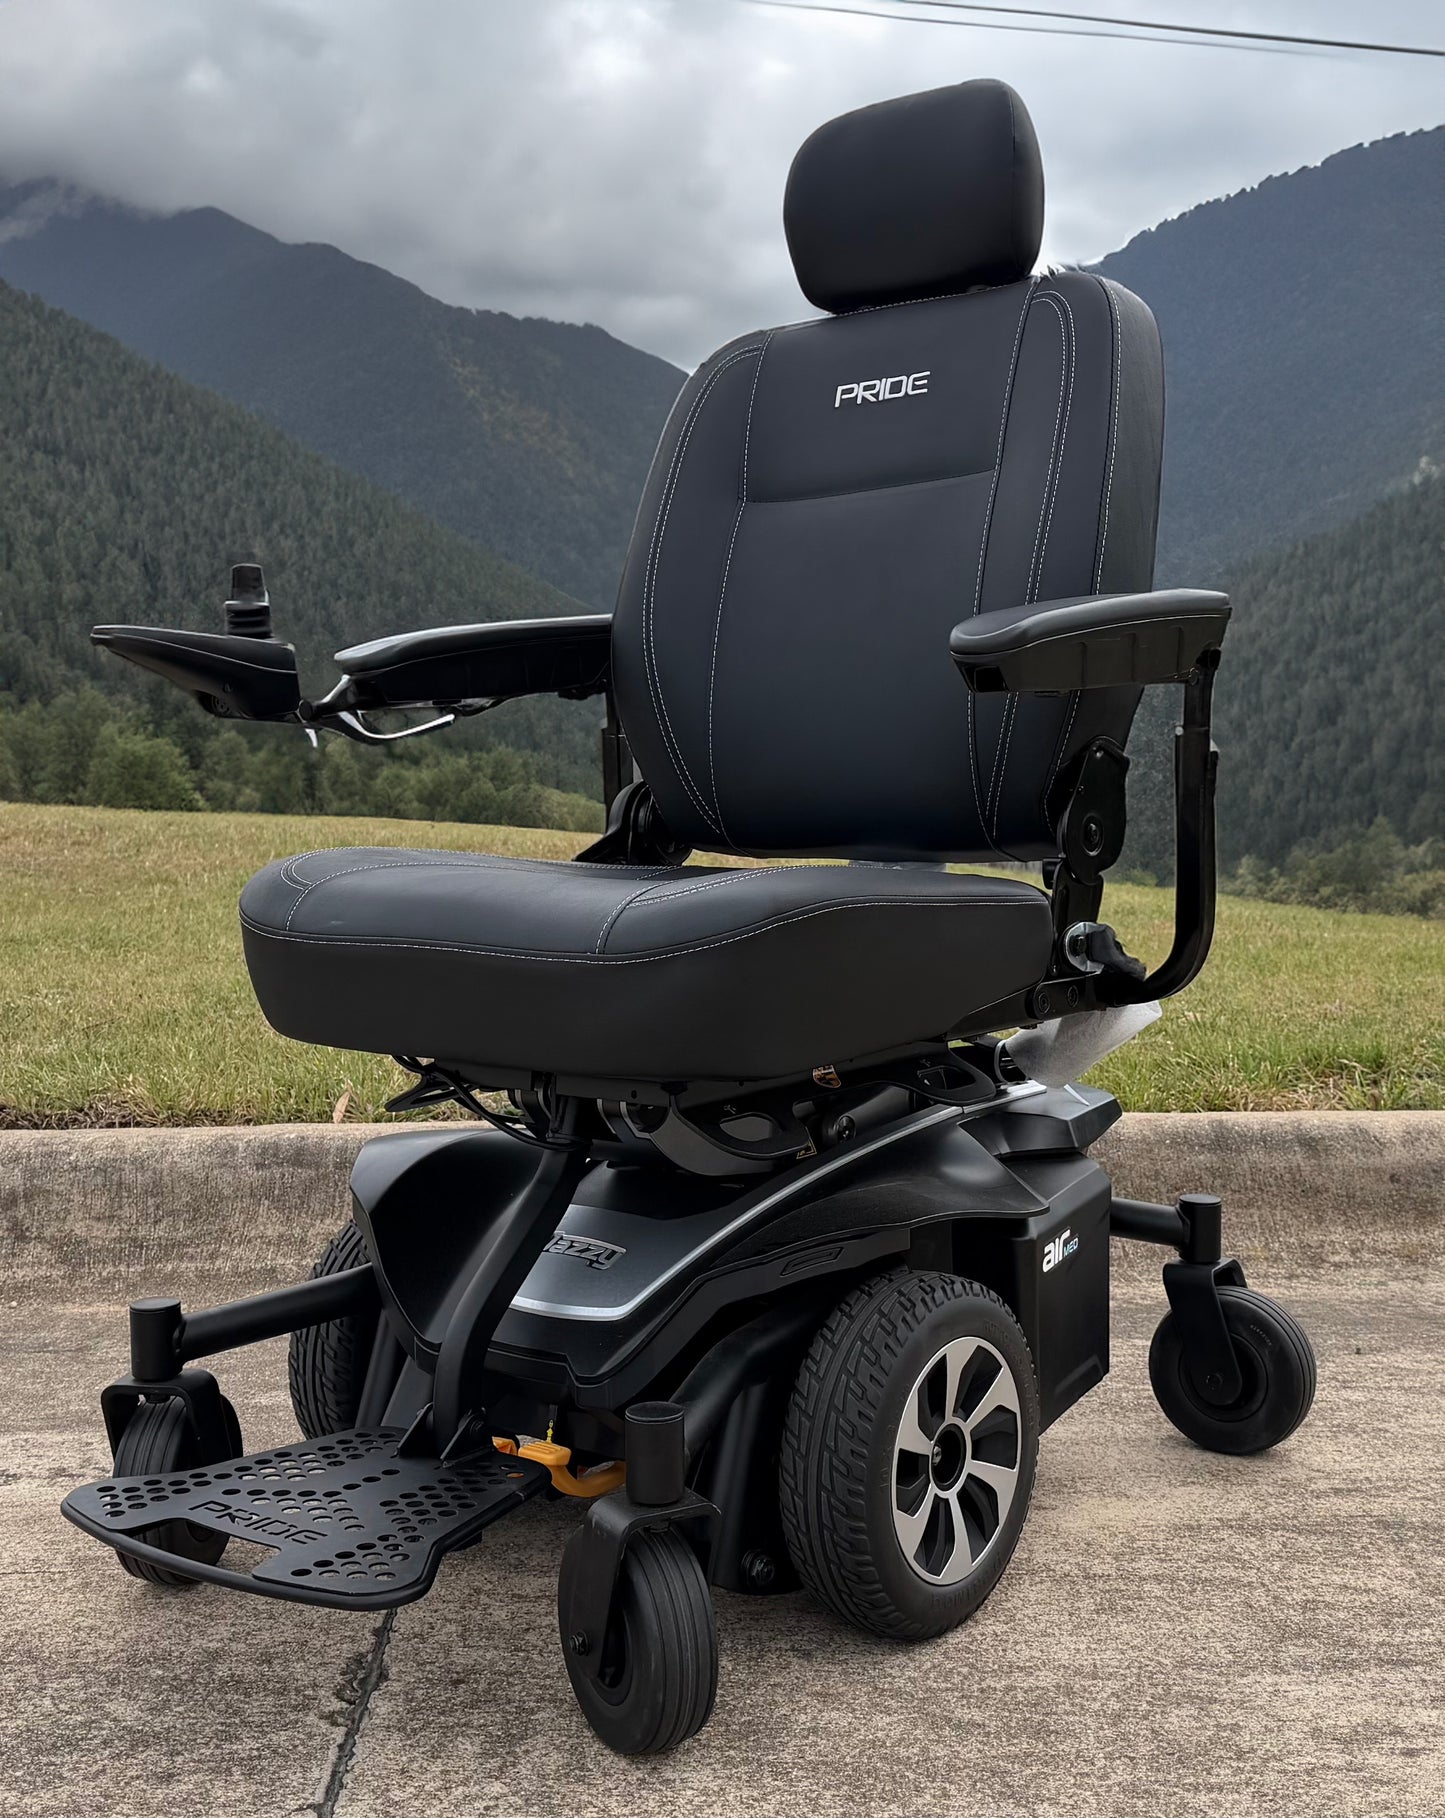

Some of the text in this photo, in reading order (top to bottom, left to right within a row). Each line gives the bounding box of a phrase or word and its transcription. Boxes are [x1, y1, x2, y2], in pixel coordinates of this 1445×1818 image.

[834, 370, 931, 408] PRIDE
[1042, 1229, 1070, 1273] air
[188, 1500, 328, 1545] PRIDE
